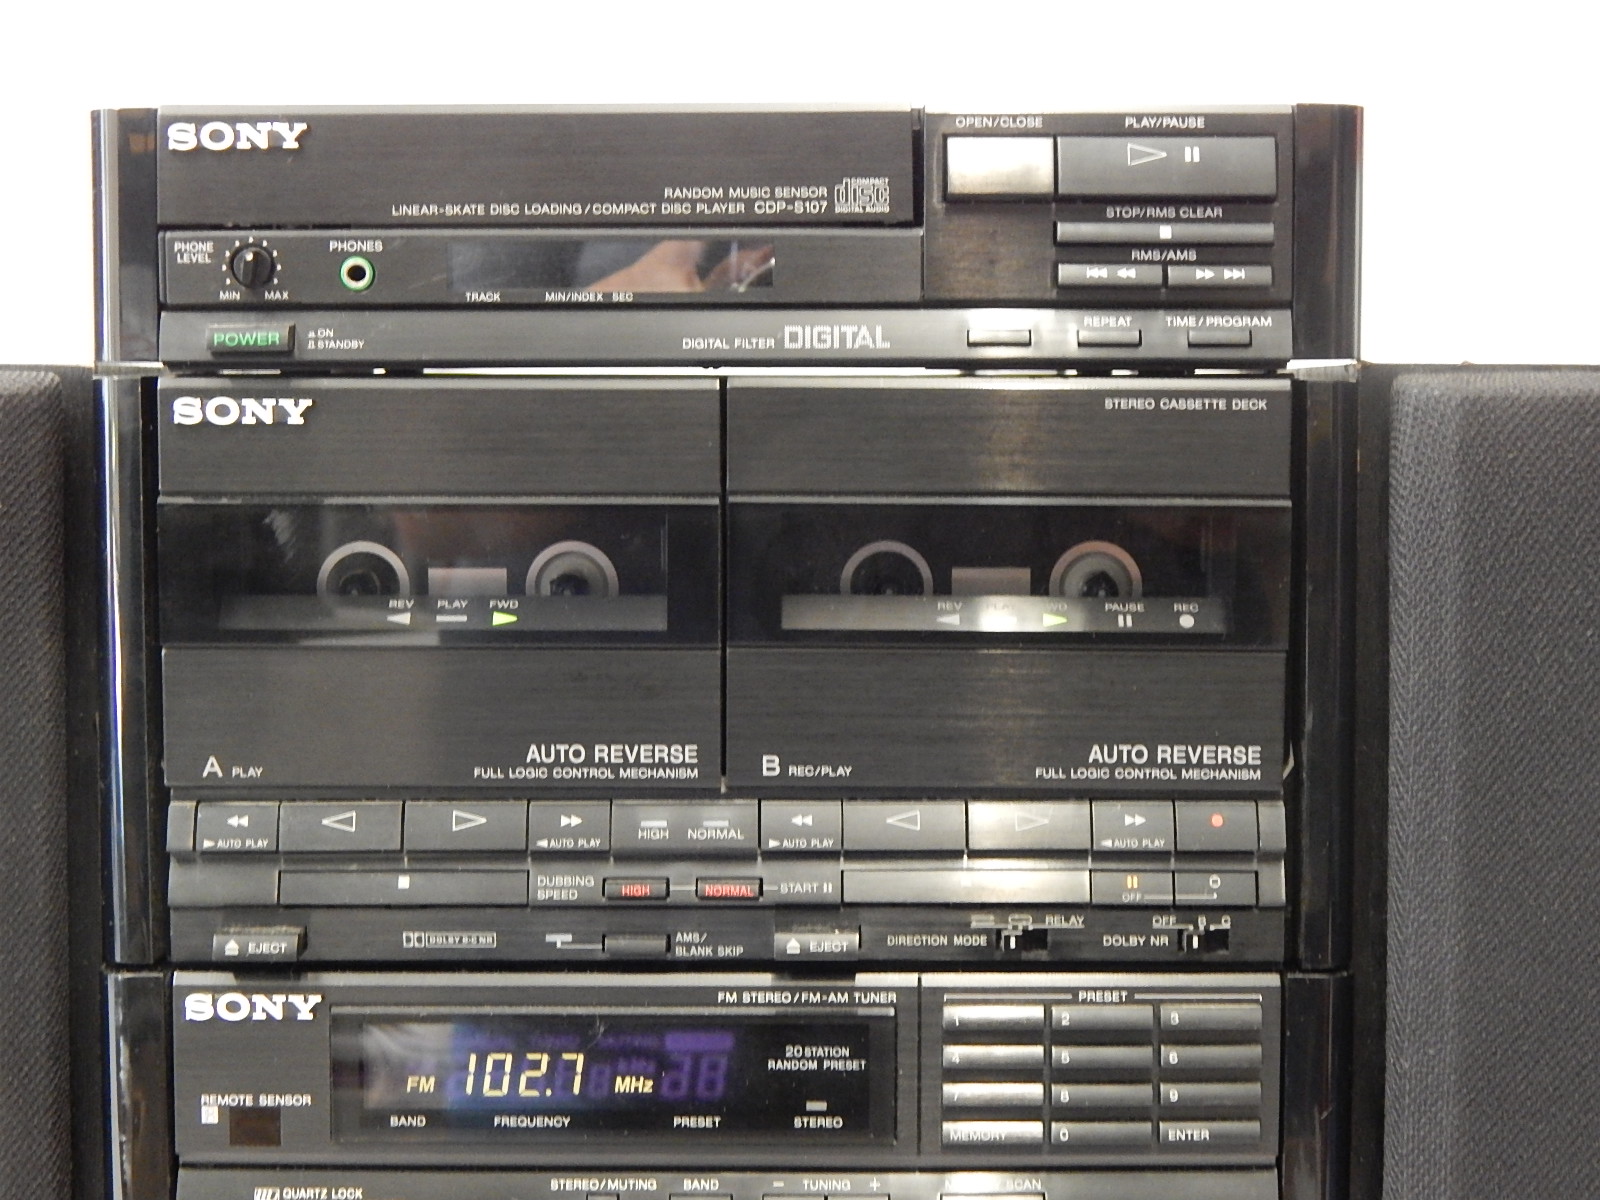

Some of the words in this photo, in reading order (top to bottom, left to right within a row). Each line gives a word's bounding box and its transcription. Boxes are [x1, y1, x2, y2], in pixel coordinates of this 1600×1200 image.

[955, 117, 1043, 129] OPEN/CLOSE
[1125, 117, 1205, 128] PLAY/PAUSE
[167, 122, 308, 151] SONY
[851, 177, 889, 186] COMPACT
[664, 187, 723, 198] RANDOM
[729, 187, 770, 198] MUSIC
[775, 187, 828, 198] SENSOR
[490, 204, 520, 216] DISC
[661, 203, 692, 215] DISC
[696, 203, 745, 215] PLAYER
[754, 201, 828, 214] CDP-S107
[835, 205, 864, 214] DIGITAL
[865, 205, 890, 214] AUDIO
[1106, 207, 1176, 218] STOP/RMS
[1180, 207, 1223, 218] CLEAR
[173, 241, 214, 253] PHONE
[329, 241, 383, 253] PHONES
[176, 253, 212, 264] LEVEL
[1131, 250, 1197, 261] RMS/AMS
[219, 290, 240, 300] MIN
[264, 290, 289, 300] MAX
[465, 292, 501, 302] TRACK
[545, 292, 604, 302] MIN/INDEX
[612, 292, 634, 302] SEC
[1084, 316, 1132, 328] REPEAT
[213, 332, 280, 346] POWER
[317, 328, 334, 338] ON
[784, 325, 890, 349] DIGITAL
[317, 339, 365, 349] STANDBY
[682, 338, 730, 350] DIGITAL
[734, 338, 775, 350] FILTER
[1104, 397, 1155, 410] STEREO
[1159, 397, 1227, 411] CASSETTE
[1232, 398, 1267, 411] DECK
[172, 396, 313, 425] SONY
[388, 599, 415, 609] REV
[437, 599, 468, 609] PLAY
[489, 599, 519, 609] FWD
[937, 602, 963, 611] REV
[1105, 602, 1145, 612] PAUSE
[1173, 603, 1199, 613] REC
[525, 745, 586, 763] AUTO
[594, 745, 699, 763] REVERSE
[1088, 745, 1148, 764] AUTO
[1157, 745, 1262, 764] REVERSE
[202, 756, 223, 777] A
[231, 767, 263, 777] PLAY
[761, 755, 781, 777] B
[788, 766, 852, 777] REC/PLAY
[474, 768, 505, 779] FULL
[509, 768, 548, 779] LOGIC
[553, 768, 615, 779] CONTROL
[620, 768, 699, 779] MECHANISM
[1035, 768, 1066, 780] FULL
[1070, 768, 1110, 780] LOGIC
[1116, 768, 1177, 780] CONTROL
[1182, 769, 1262, 780] MECHANISM
[638, 829, 669, 840] HIGH
[687, 829, 744, 840] NORMAL
[217, 838, 242, 849] AUTO
[245, 838, 269, 849] PLAY
[549, 838, 574, 849] AUTO
[578, 838, 601, 849] PLAY
[782, 838, 807, 849] AUTO
[811, 838, 834, 849] PLAY
[1114, 838, 1139, 849] AUTO
[1142, 838, 1165, 849] PLAY
[537, 875, 595, 888] DUBBING
[621, 885, 650, 896] HIGH
[705, 885, 754, 897] NORMAL
[780, 882, 818, 894] START
[537, 889, 578, 901] SPEED
[1045, 915, 1085, 926] RELAY
[1152, 915, 1177, 926] OFF
[675, 932, 707, 943] AMS/
[887, 935, 948, 947] DIRECTION
[953, 935, 988, 947] MODE
[1102, 935, 1146, 947] DOLBY
[1149, 935, 1169, 947] NR
[248, 943, 288, 955] EJECT
[675, 945, 713, 957] BLANK
[717, 945, 744, 957] SKIP
[809, 941, 849, 953] EJECT
[717, 992, 738, 1004] FM
[854, 992, 897, 1004] TUNER
[1078, 991, 1128, 1003] PRESET
[184, 993, 323, 1021] SONY
[1061, 1012, 1070, 1026] 2
[1170, 1012, 1180, 1026] 3
[785, 1045, 803, 1057] 20
[804, 1046, 850, 1058] STATION
[1061, 1051, 1070, 1065] 5
[1169, 1051, 1179, 1065] 6
[768, 1059, 818, 1071] RANDOM
[823, 1059, 867, 1071] PRESET
[465, 1052, 585, 1097] 102.7
[407, 1075, 436, 1094] FM
[614, 1075, 654, 1094] MHz
[201, 1094, 254, 1106] REMOTE
[259, 1094, 312, 1106] SENSOR
[1060, 1089, 1070, 1103] 8
[1169, 1089, 1179, 1103] 9
[390, 1116, 427, 1127] BAND
[493, 1115, 571, 1128] FREQUENCY
[673, 1115, 722, 1128] PRESET
[793, 1116, 844, 1128] STEREO
[949, 1129, 1007, 1141] MEMORY
[1168, 1129, 1210, 1141] ENTER
[550, 1178, 658, 1191] STEREO/MUTING
[683, 1179, 719, 1190] BAND
[802, 1179, 851, 1191] TUNING
[1005, 1179, 1042, 1190] SCAN
[282, 1187, 328, 1200] QUARTZ
[331, 1188, 363, 1200] LOCK
